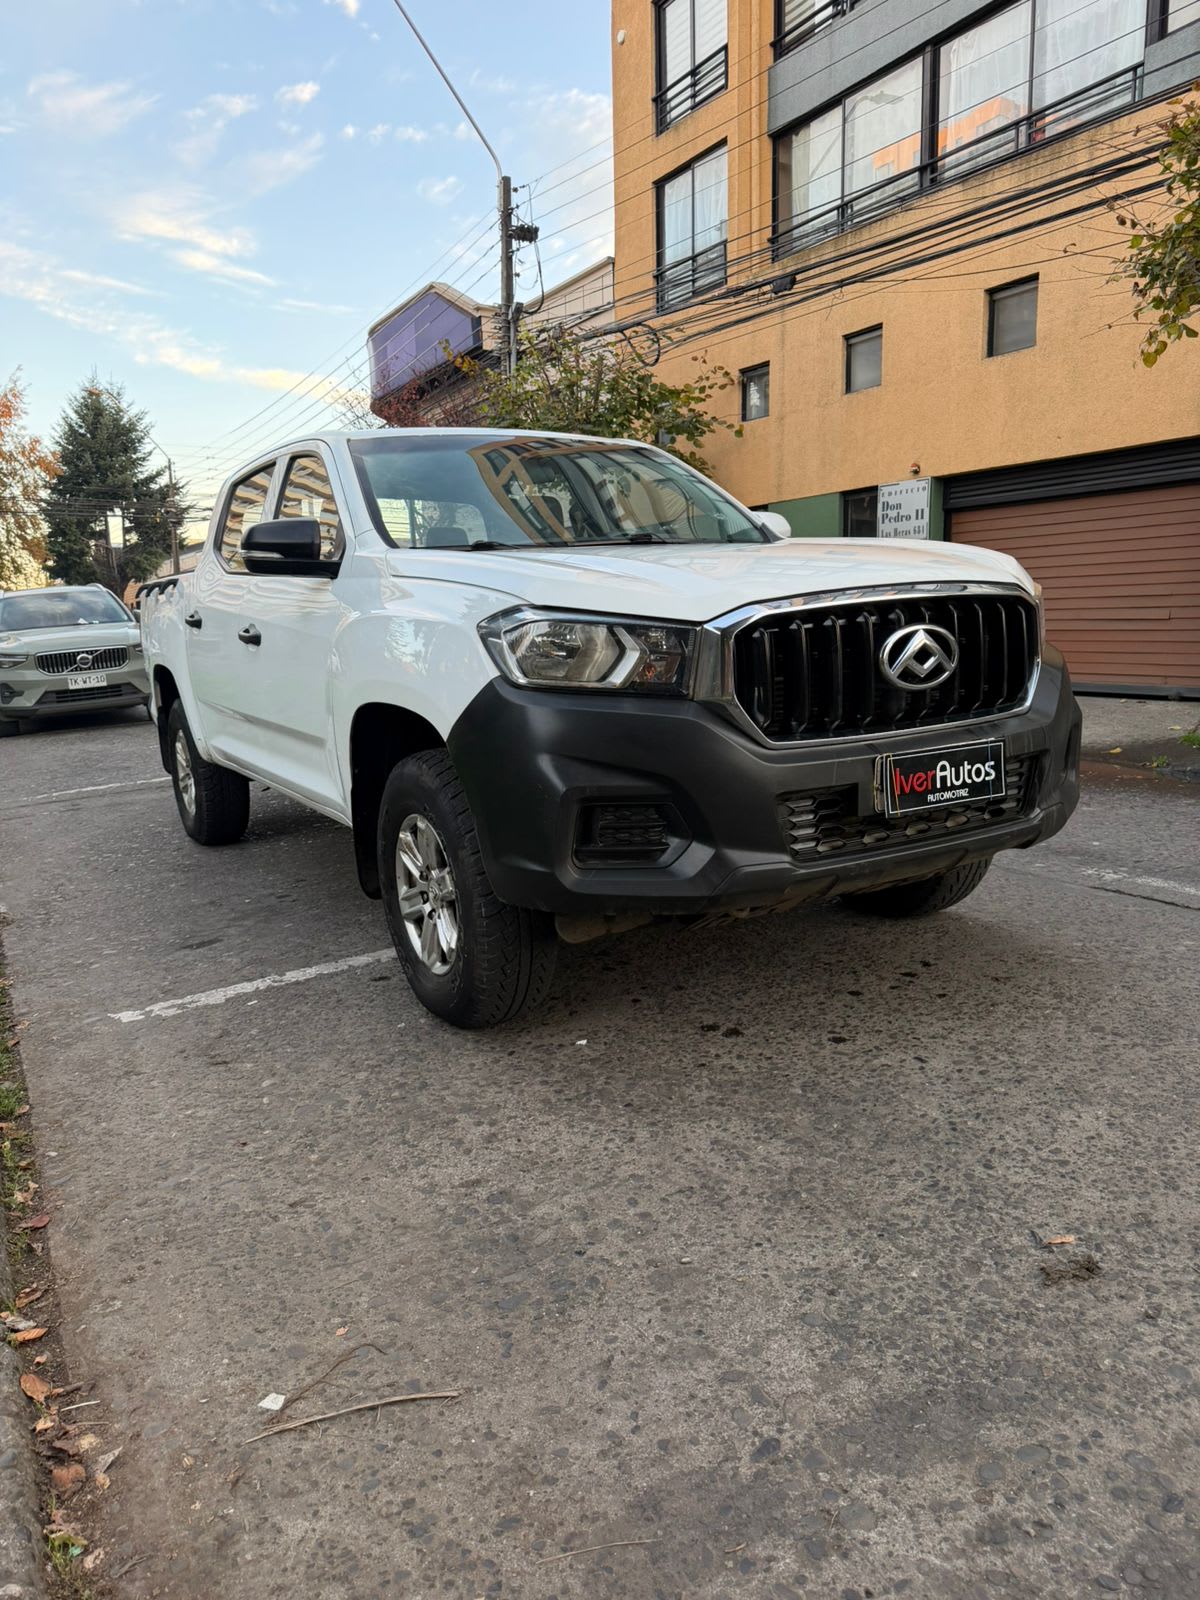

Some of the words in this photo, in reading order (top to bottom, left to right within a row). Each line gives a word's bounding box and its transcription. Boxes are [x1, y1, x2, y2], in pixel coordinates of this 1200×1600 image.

[881, 500, 902, 512] Don
[881, 511, 912, 524] Pedro
[915, 508, 925, 520] II
[927, 788, 969, 802] AUTOMOTRIZ
